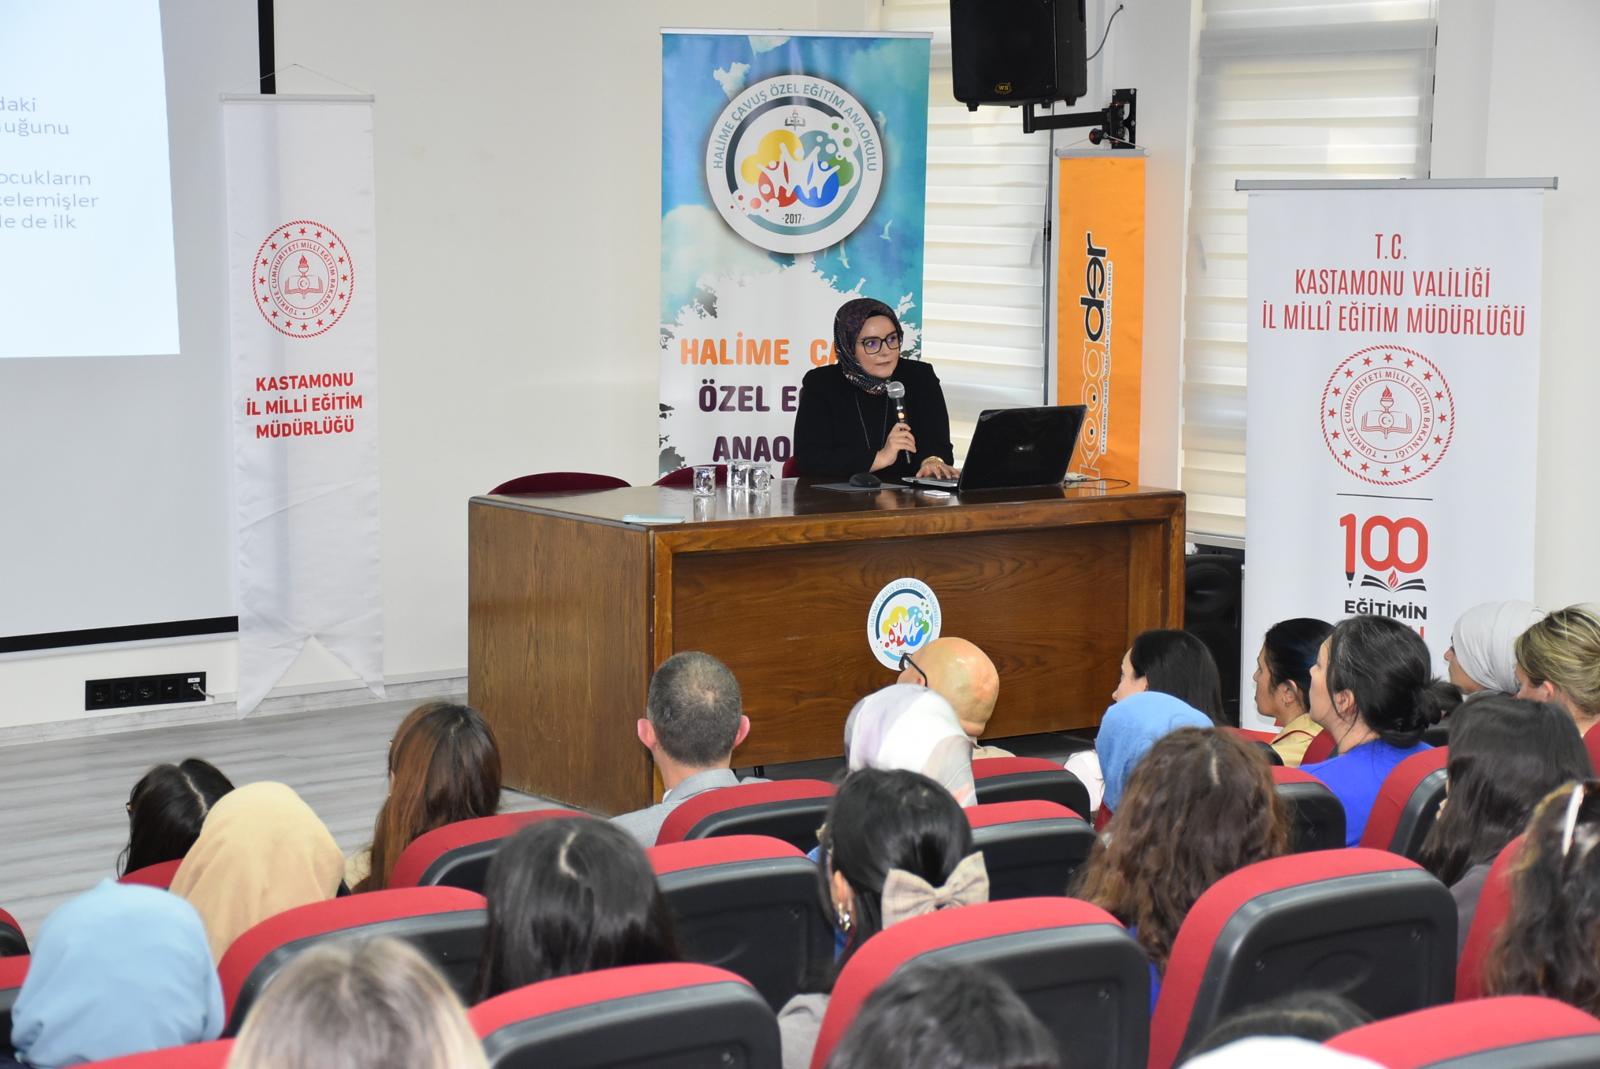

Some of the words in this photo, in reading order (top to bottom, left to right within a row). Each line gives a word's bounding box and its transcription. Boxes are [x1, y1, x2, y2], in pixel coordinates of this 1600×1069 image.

[0, 118, 70, 137] uğunu
[732, 91, 768, 122] ÇAVUŞ
[770, 83, 799, 97] ÖZEL
[803, 83, 845, 109] EĞİTİM
[843, 106, 878, 172] ANAOKULU
[0, 170, 92, 186] ocukların
[21, 214, 48, 229] de
[53, 214, 77, 230] ilk
[1295, 268, 1405, 296] KASTAMONU
[1412, 266, 1491, 298] VALİLİĞİ
[1262, 300, 1277, 329] İL
[1283, 300, 1333, 331] MİLLÎ
[1338, 301, 1399, 333] EĞİTİM
[1406, 303, 1526, 336] MÜDÜRLÜĞÜ
[680, 331, 790, 366] HALİME
[256, 372, 354, 392] KASTAMONU
[698, 378, 770, 412] ÖZEL
[246, 398, 261, 416] İL
[265, 394, 308, 415] MİLLİ
[311, 392, 363, 412] EĞİTİM
[1344, 370, 1382, 424] CUMHURİYETİ
[256, 415, 355, 439] MÜDÜRLÜĞÜ
[712, 435, 791, 463] ANAO
[1339, 513, 1429, 580] 100
[1344, 597, 1428, 620] EĞİTİMİN
